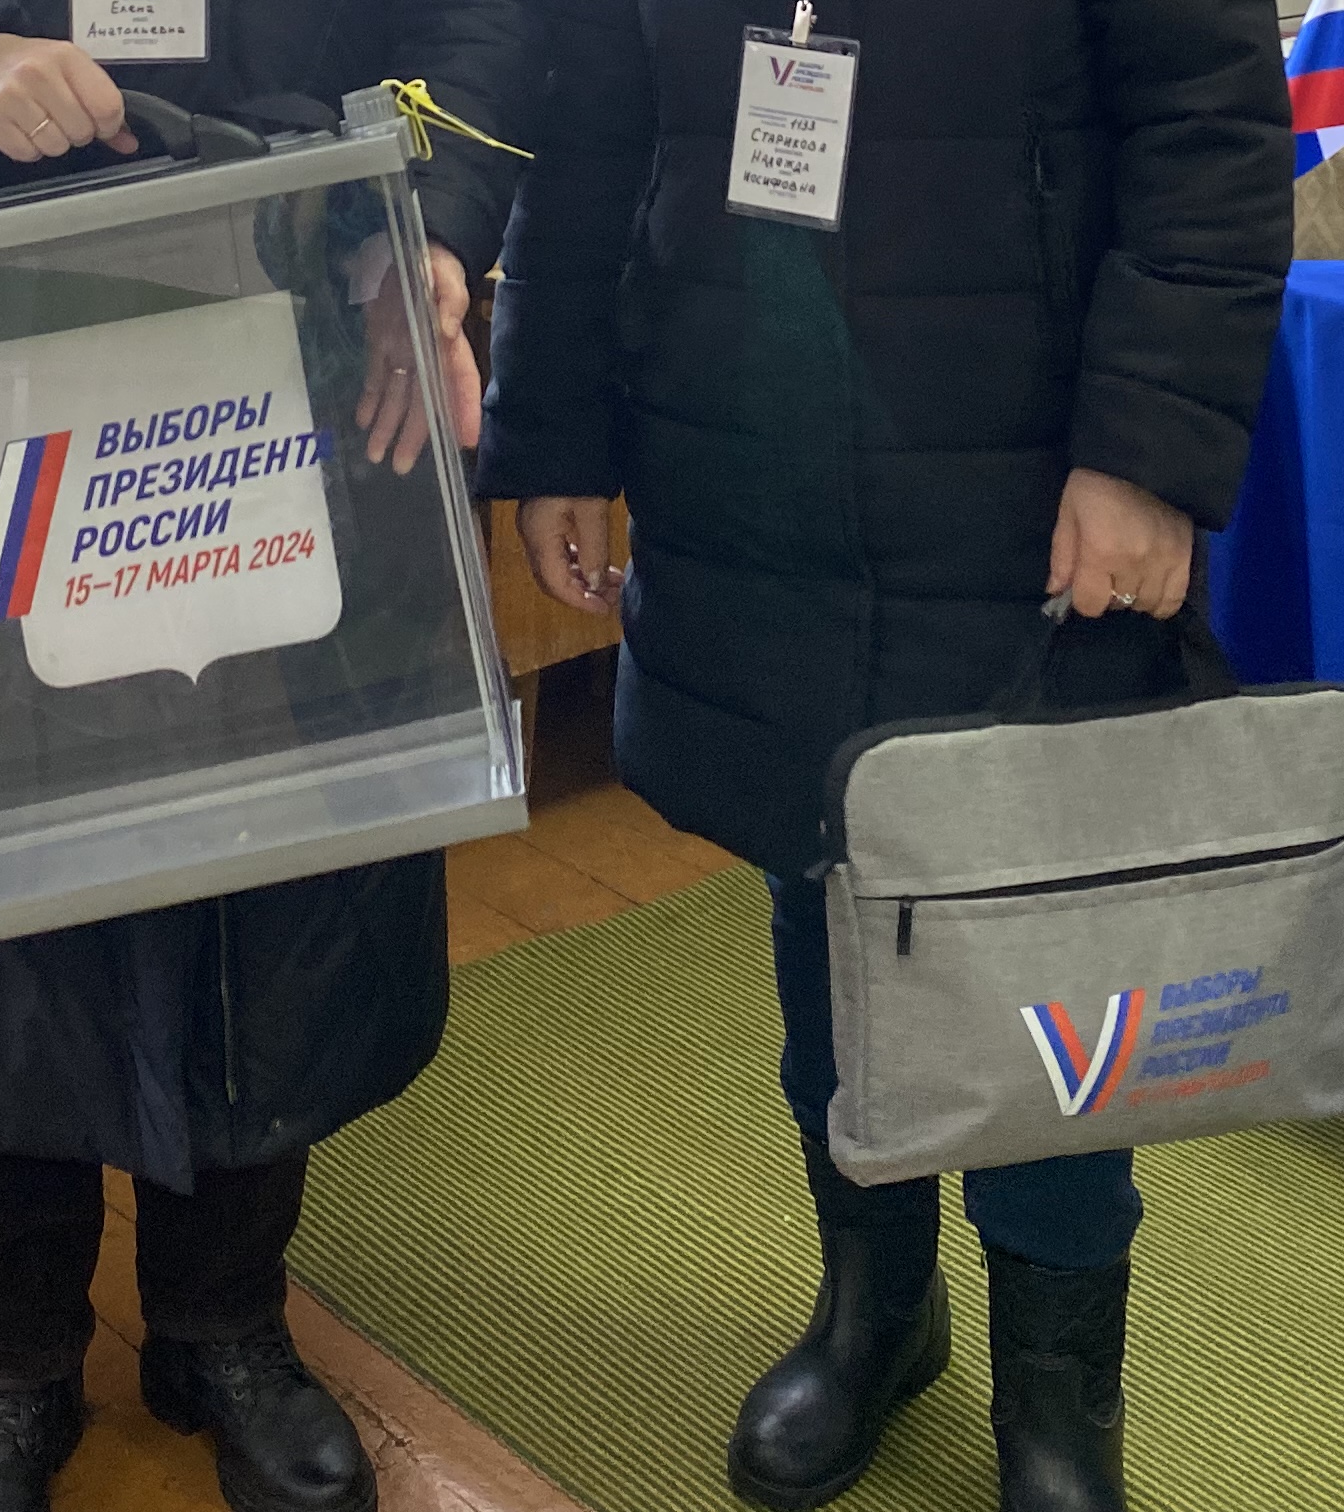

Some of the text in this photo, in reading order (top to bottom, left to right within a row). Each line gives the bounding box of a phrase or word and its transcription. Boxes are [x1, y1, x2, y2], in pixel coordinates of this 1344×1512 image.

[110, 0, 155, 15] Елена
[95, 392, 273, 459] ВЫБОРЫ
[83, 430, 335, 511] ПРЕЗИДЕНТА
[71, 498, 233, 563] РОССИИ
[147, 549, 242, 592] МАРТА
[249, 529, 316, 572] 2024
